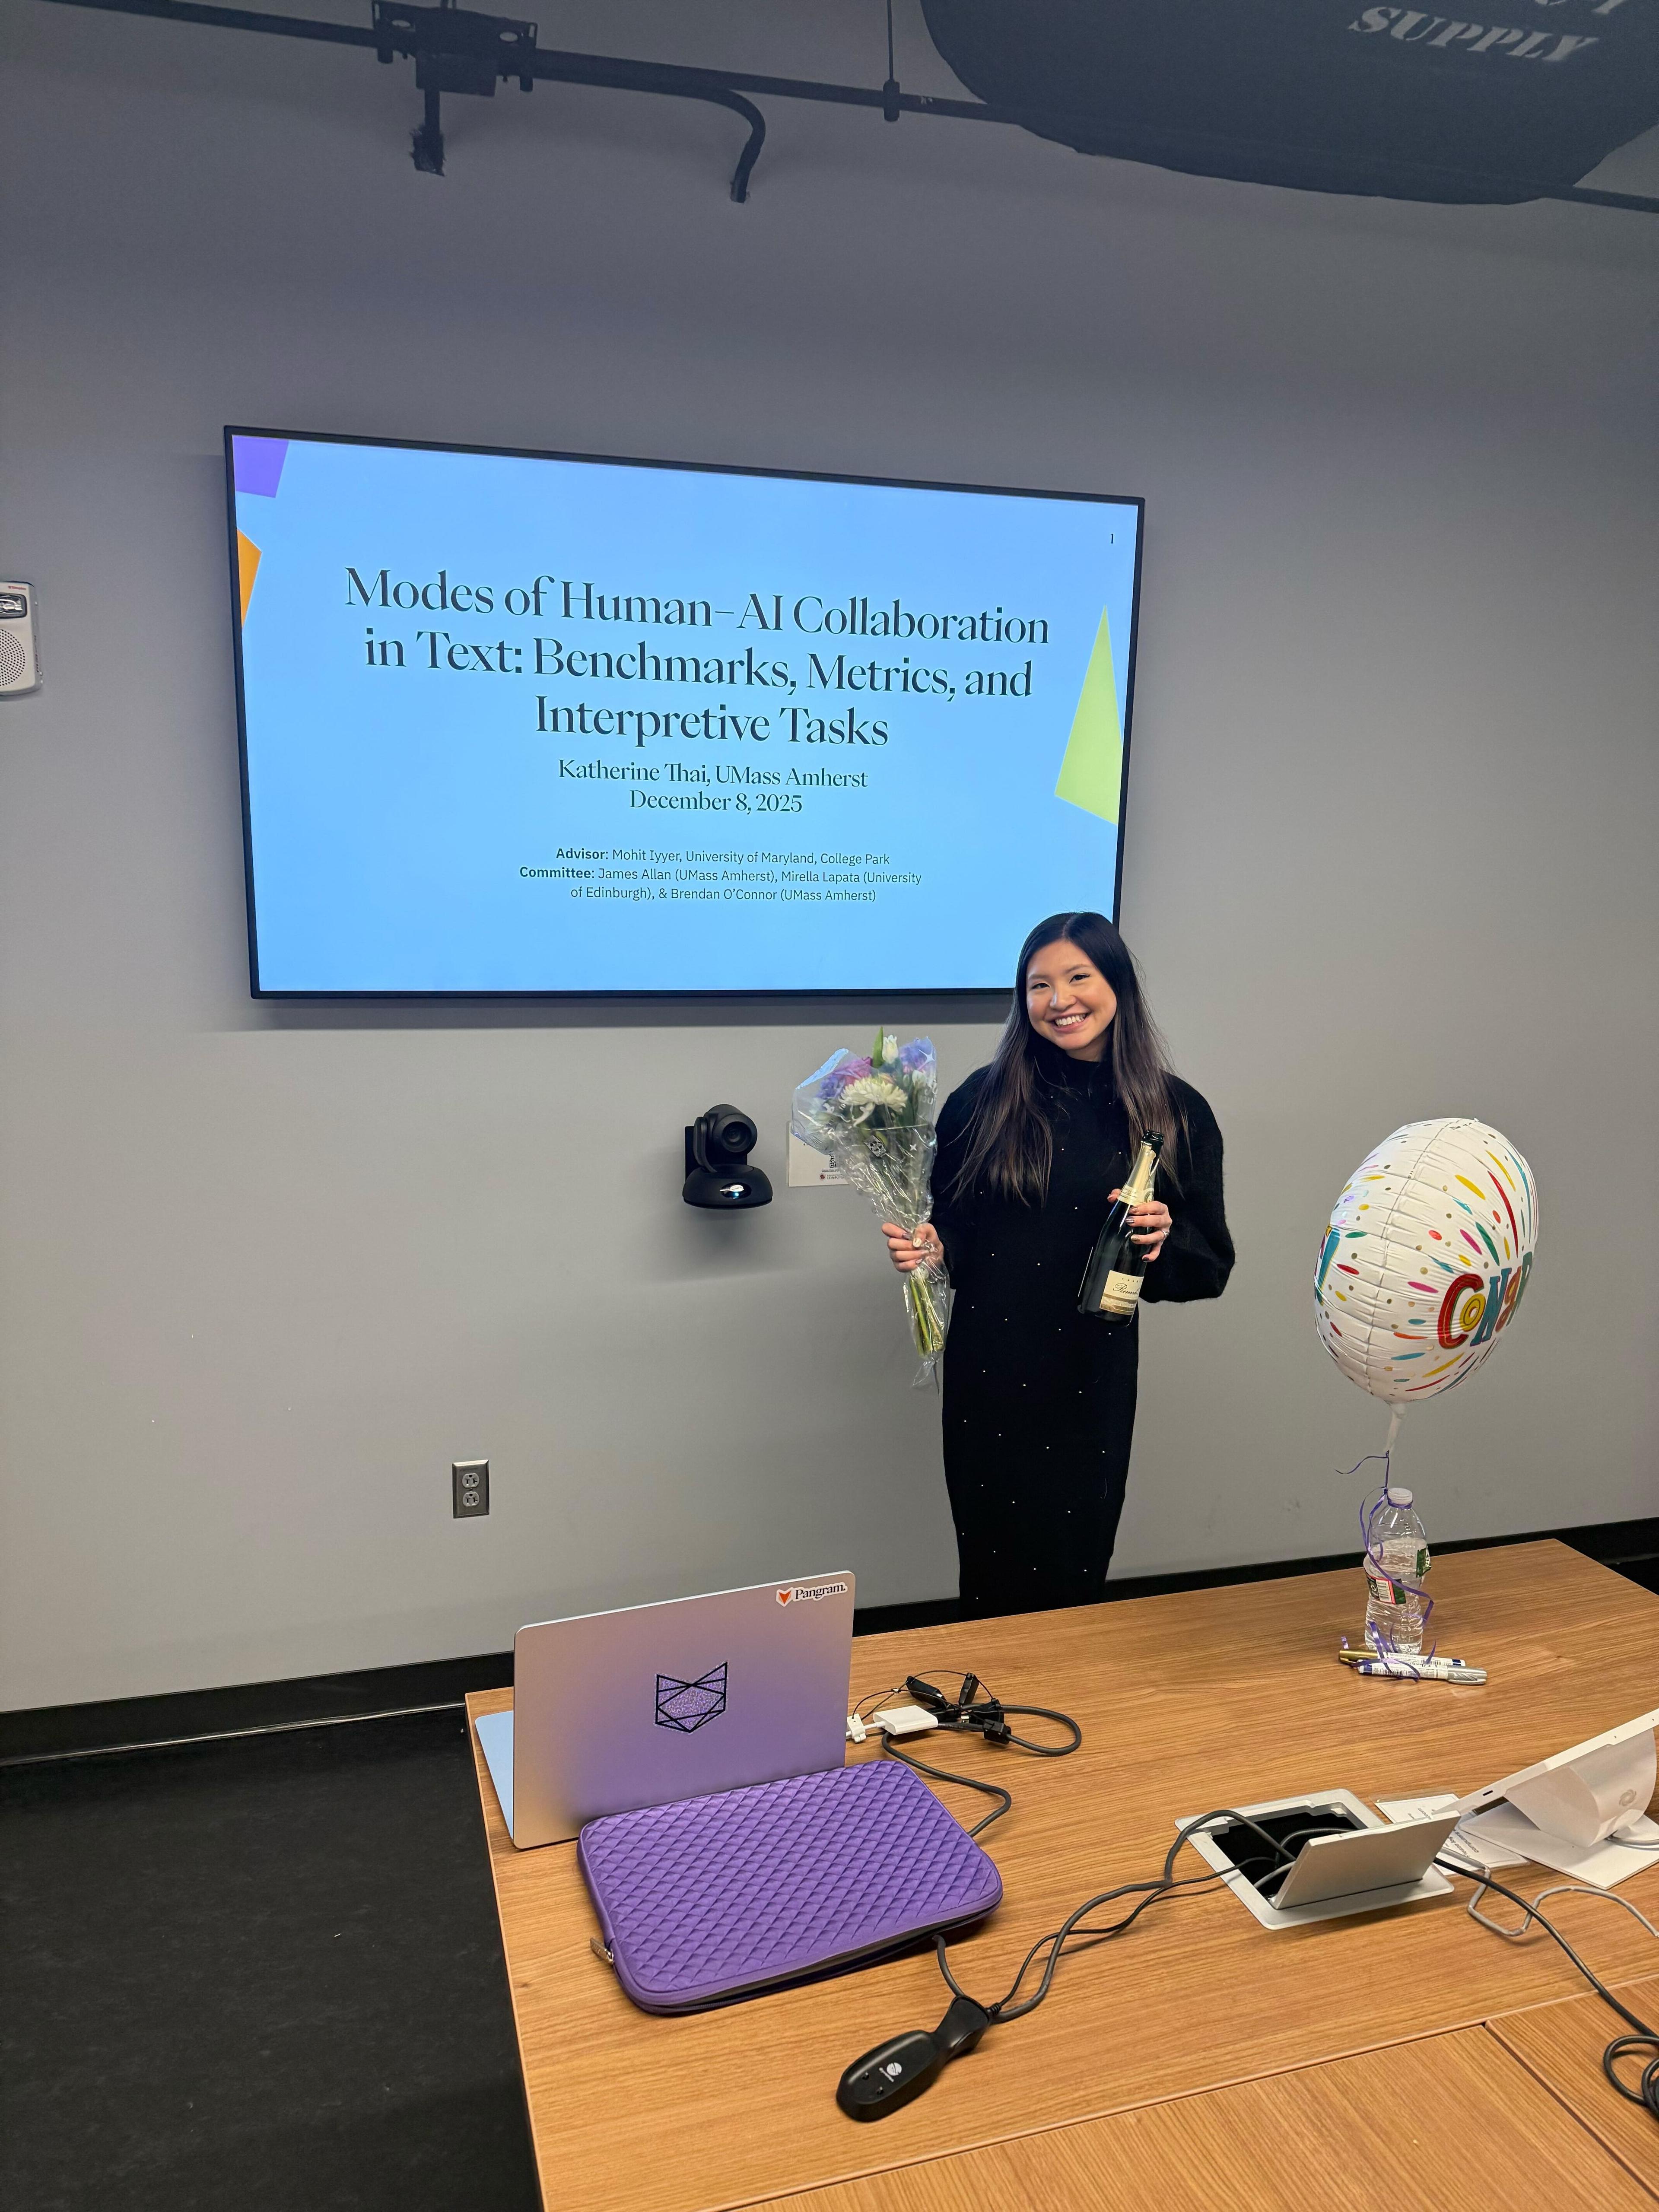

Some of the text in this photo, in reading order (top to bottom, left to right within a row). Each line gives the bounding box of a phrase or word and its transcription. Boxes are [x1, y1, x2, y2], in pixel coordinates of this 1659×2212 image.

[1348, 6, 1599, 62] SUPPLY
[1110, 533, 1114, 544] 1
[345, 567, 493, 613] Modes
[505, 575, 555, 616] of
[794, 596, 1049, 643] Collaboration
[365, 628, 1032, 702] in Text: Benchmarks, Metrics, and
[535, 696, 888, 747] Interpretive Tasks
[559, 760, 868, 787] Katherine Thai, UMass Amherst
[630, 790, 802, 814] December 8, 2025
[556, 848, 889, 866] Advisor: Mohit Iyyer, University of Maryland, College Park
[520, 867, 921, 885] Committee: James Allan (UMass Amherst), Mirella Lapata (University
[571, 887, 582, 897] of
[587, 887, 654, 901] Edinburgh),
[659, 888, 667, 898] &
[671, 888, 719, 899] Brendan
[781, 889, 821, 901] (UMass
[825, 890, 875, 902] Amherst)
[795, 1584, 846, 1599] Pangram.
